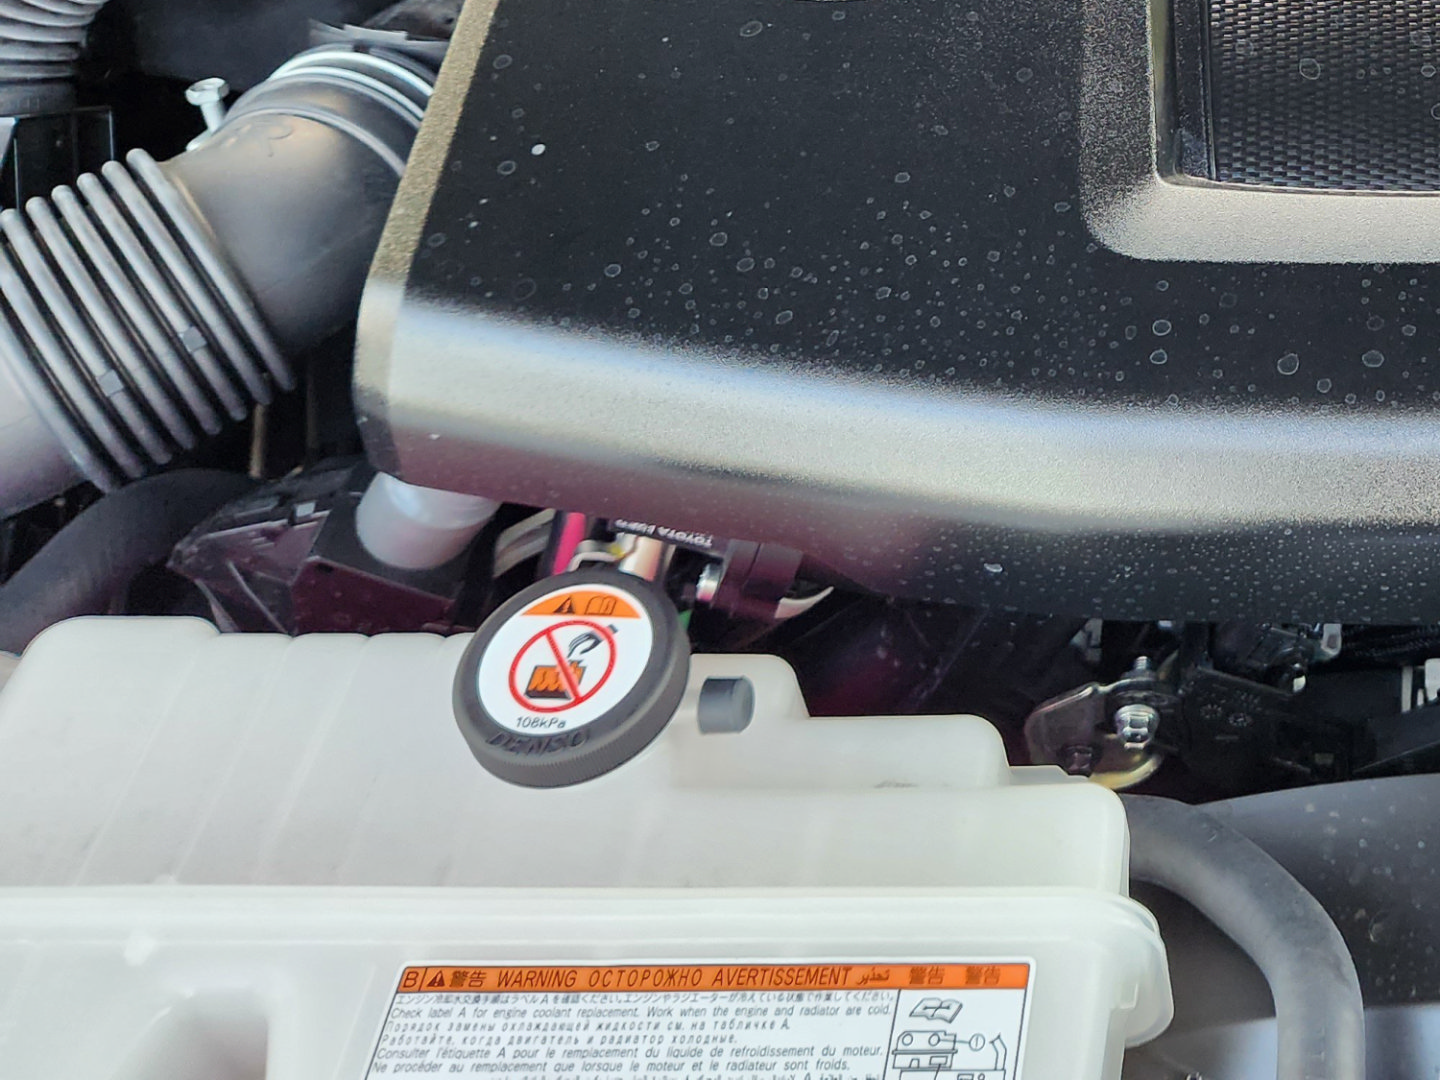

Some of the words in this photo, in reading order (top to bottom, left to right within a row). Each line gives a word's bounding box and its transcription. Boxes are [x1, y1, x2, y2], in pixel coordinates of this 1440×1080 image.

[657, 526, 714, 548] TOYOTA
[516, 716, 566, 729] 108kPa
[486, 730, 590, 755] DENSO
[403, 971, 419, 988] B
[497, 970, 578, 988] WARNING
[588, 969, 702, 987] ОСТОРОЖНО
[712, 966, 853, 986] AVERTISSEMENT
[391, 1007, 425, 1019] Check
[428, 1007, 454, 1018] label
[458, 1007, 466, 1018] A
[473, 1007, 488, 1018] for
[493, 1007, 527, 1020] engine
[533, 1007, 572, 1018] coolant
[647, 1006, 673, 1017] Work
[680, 1006, 706, 1017] when
[712, 1005, 729, 1016] the
[734, 1006, 768, 1019] engine
[774, 1005, 794, 1016] and
[800, 1005, 840, 1016] radiator
[845, 1006, 862, 1016] are
[868, 1004, 892, 1016] cold.
[377, 1048, 430, 1060] Consulter
[496, 1047, 506, 1058] A
[512, 1049, 539, 1061] pour
[545, 1047, 555, 1058] le
[562, 1047, 639, 1059] remplacement
[645, 1047, 660, 1058] du
[666, 1046, 704, 1059] liquide
[709, 1046, 724, 1058] de
[730, 1045, 814, 1057] refroidissement
[821, 1045, 836, 1056] du
[843, 1046, 883, 1056] moteur.
[373, 1062, 388, 1073] Ne
[393, 1062, 443, 1074] procéder
[450, 1064, 465, 1073] au
[471, 1062, 548, 1074] remplacement
[554, 1063, 575, 1073] que
[581, 1061, 623, 1073] lorsque
[629, 1061, 639, 1071] le
[646, 1062, 685, 1071] moteur
[691, 1061, 703, 1071] et
[709, 1060, 719, 1070] le
[726, 1060, 777, 1070] radiateur
[784, 1061, 809, 1070] sont
[816, 1059, 850, 1070] froids.
